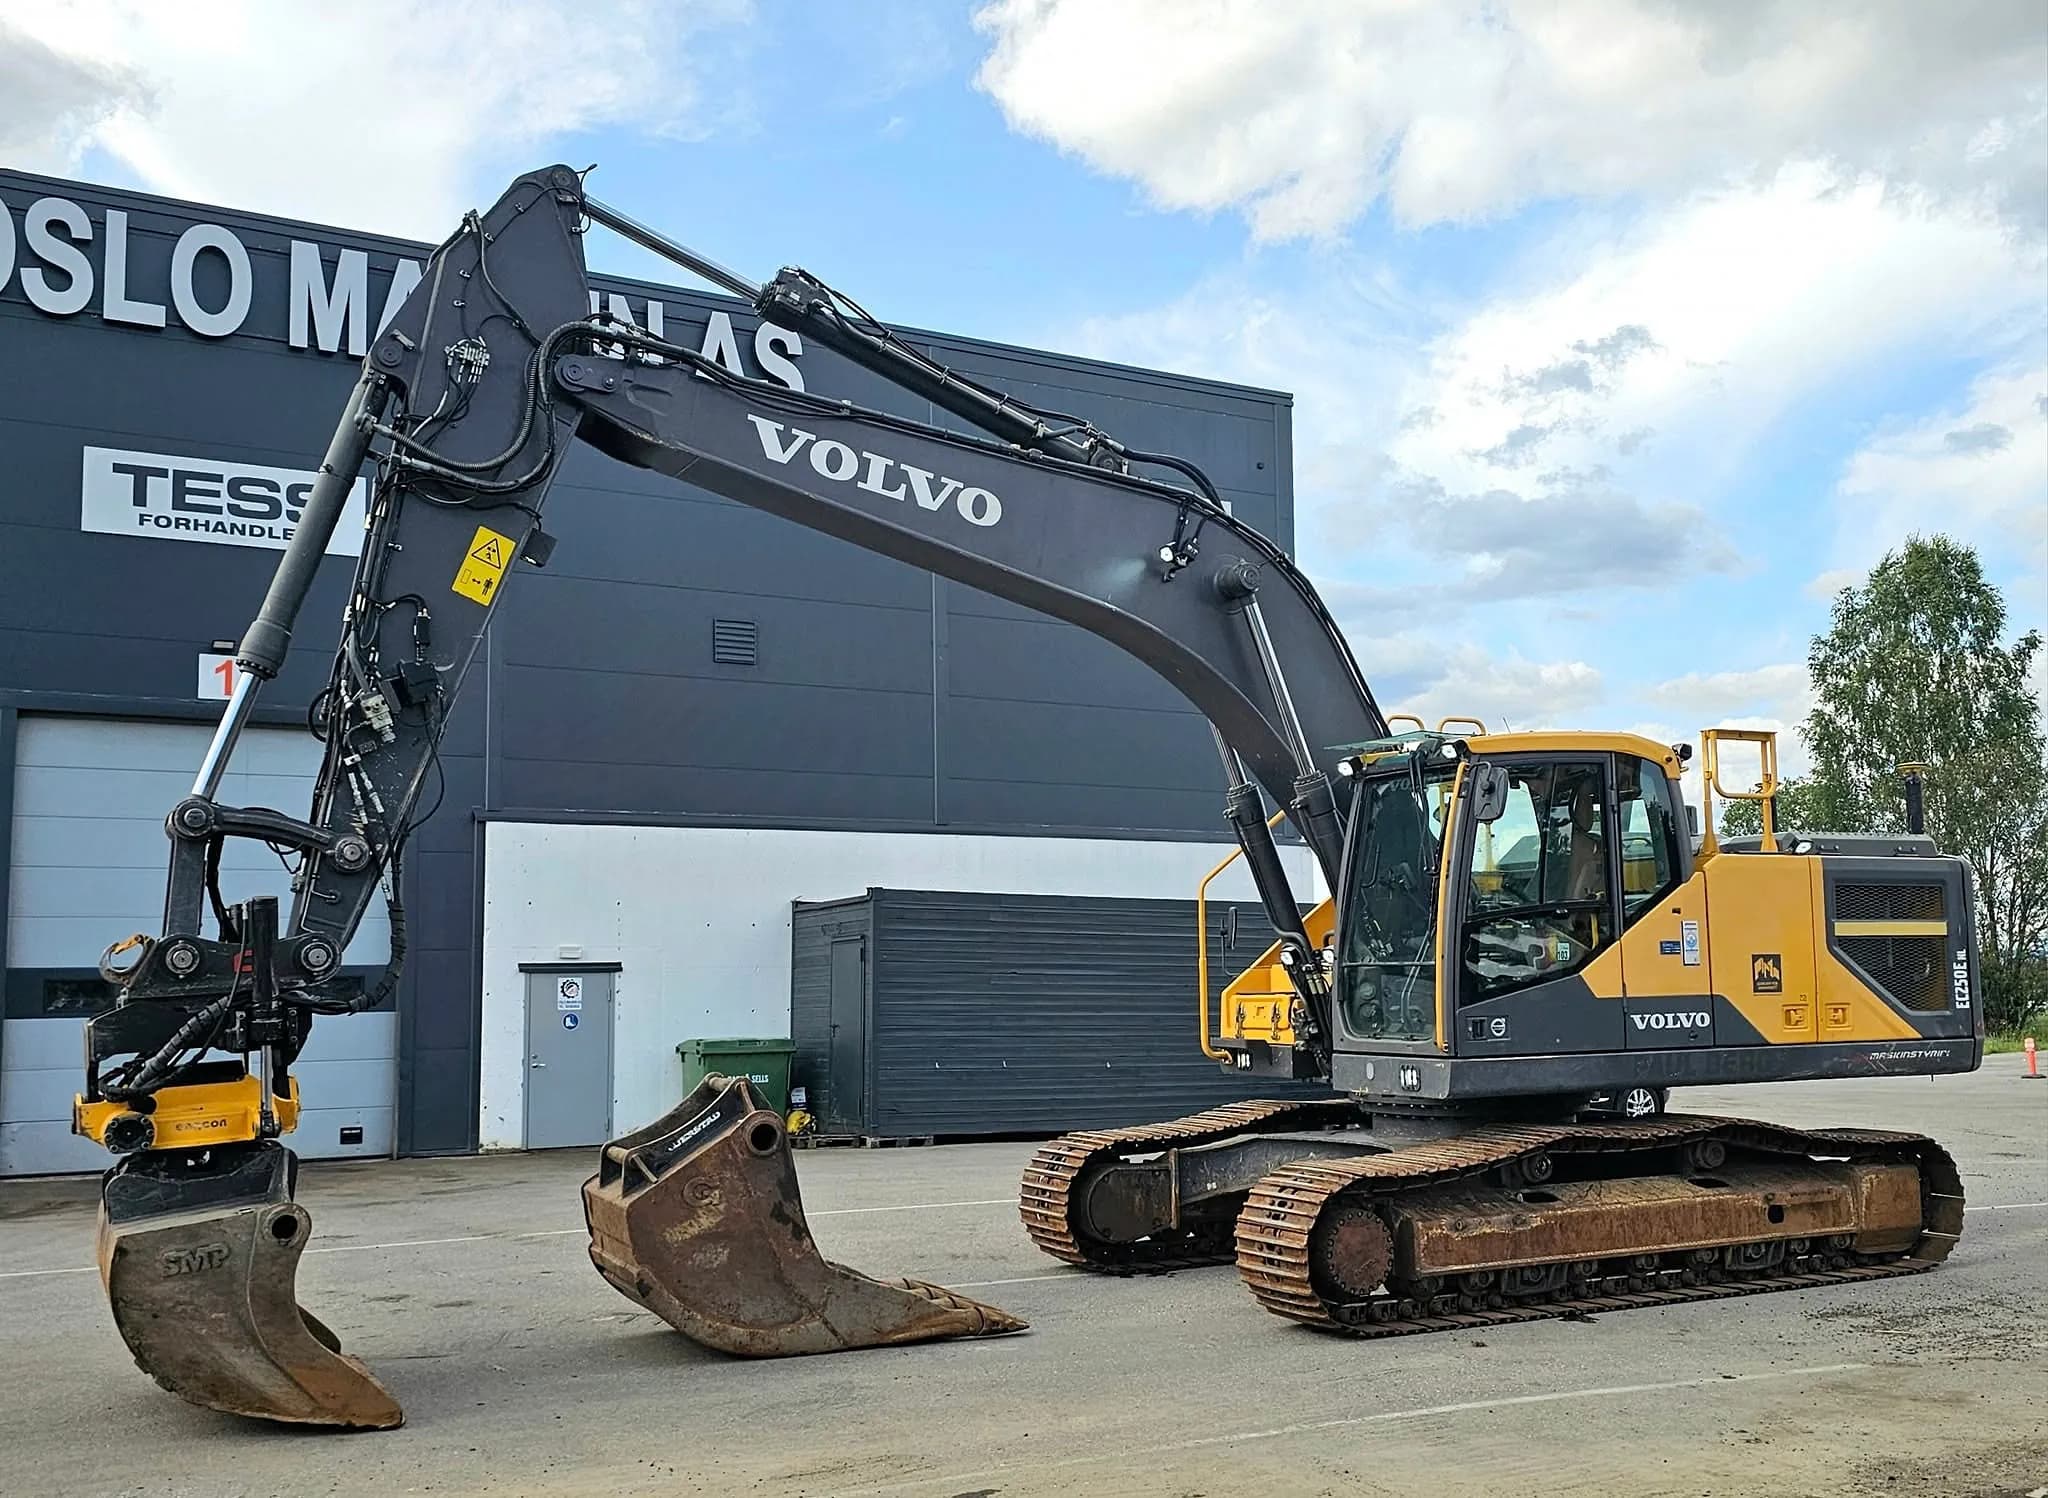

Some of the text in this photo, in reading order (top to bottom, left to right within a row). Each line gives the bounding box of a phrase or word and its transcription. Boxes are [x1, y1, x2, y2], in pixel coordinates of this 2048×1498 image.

[0, 195, 254, 338] SLO
[695, 310, 806, 394] AS
[747, 413, 1003, 528] VOLVO
[138, 512, 297, 541] FORHANDLE
[215, 659, 234, 696] 1
[1953, 961, 1970, 1009] EC250E
[1629, 1011, 1711, 1031] VOLVO
[160, 1243, 230, 1278] SMP
